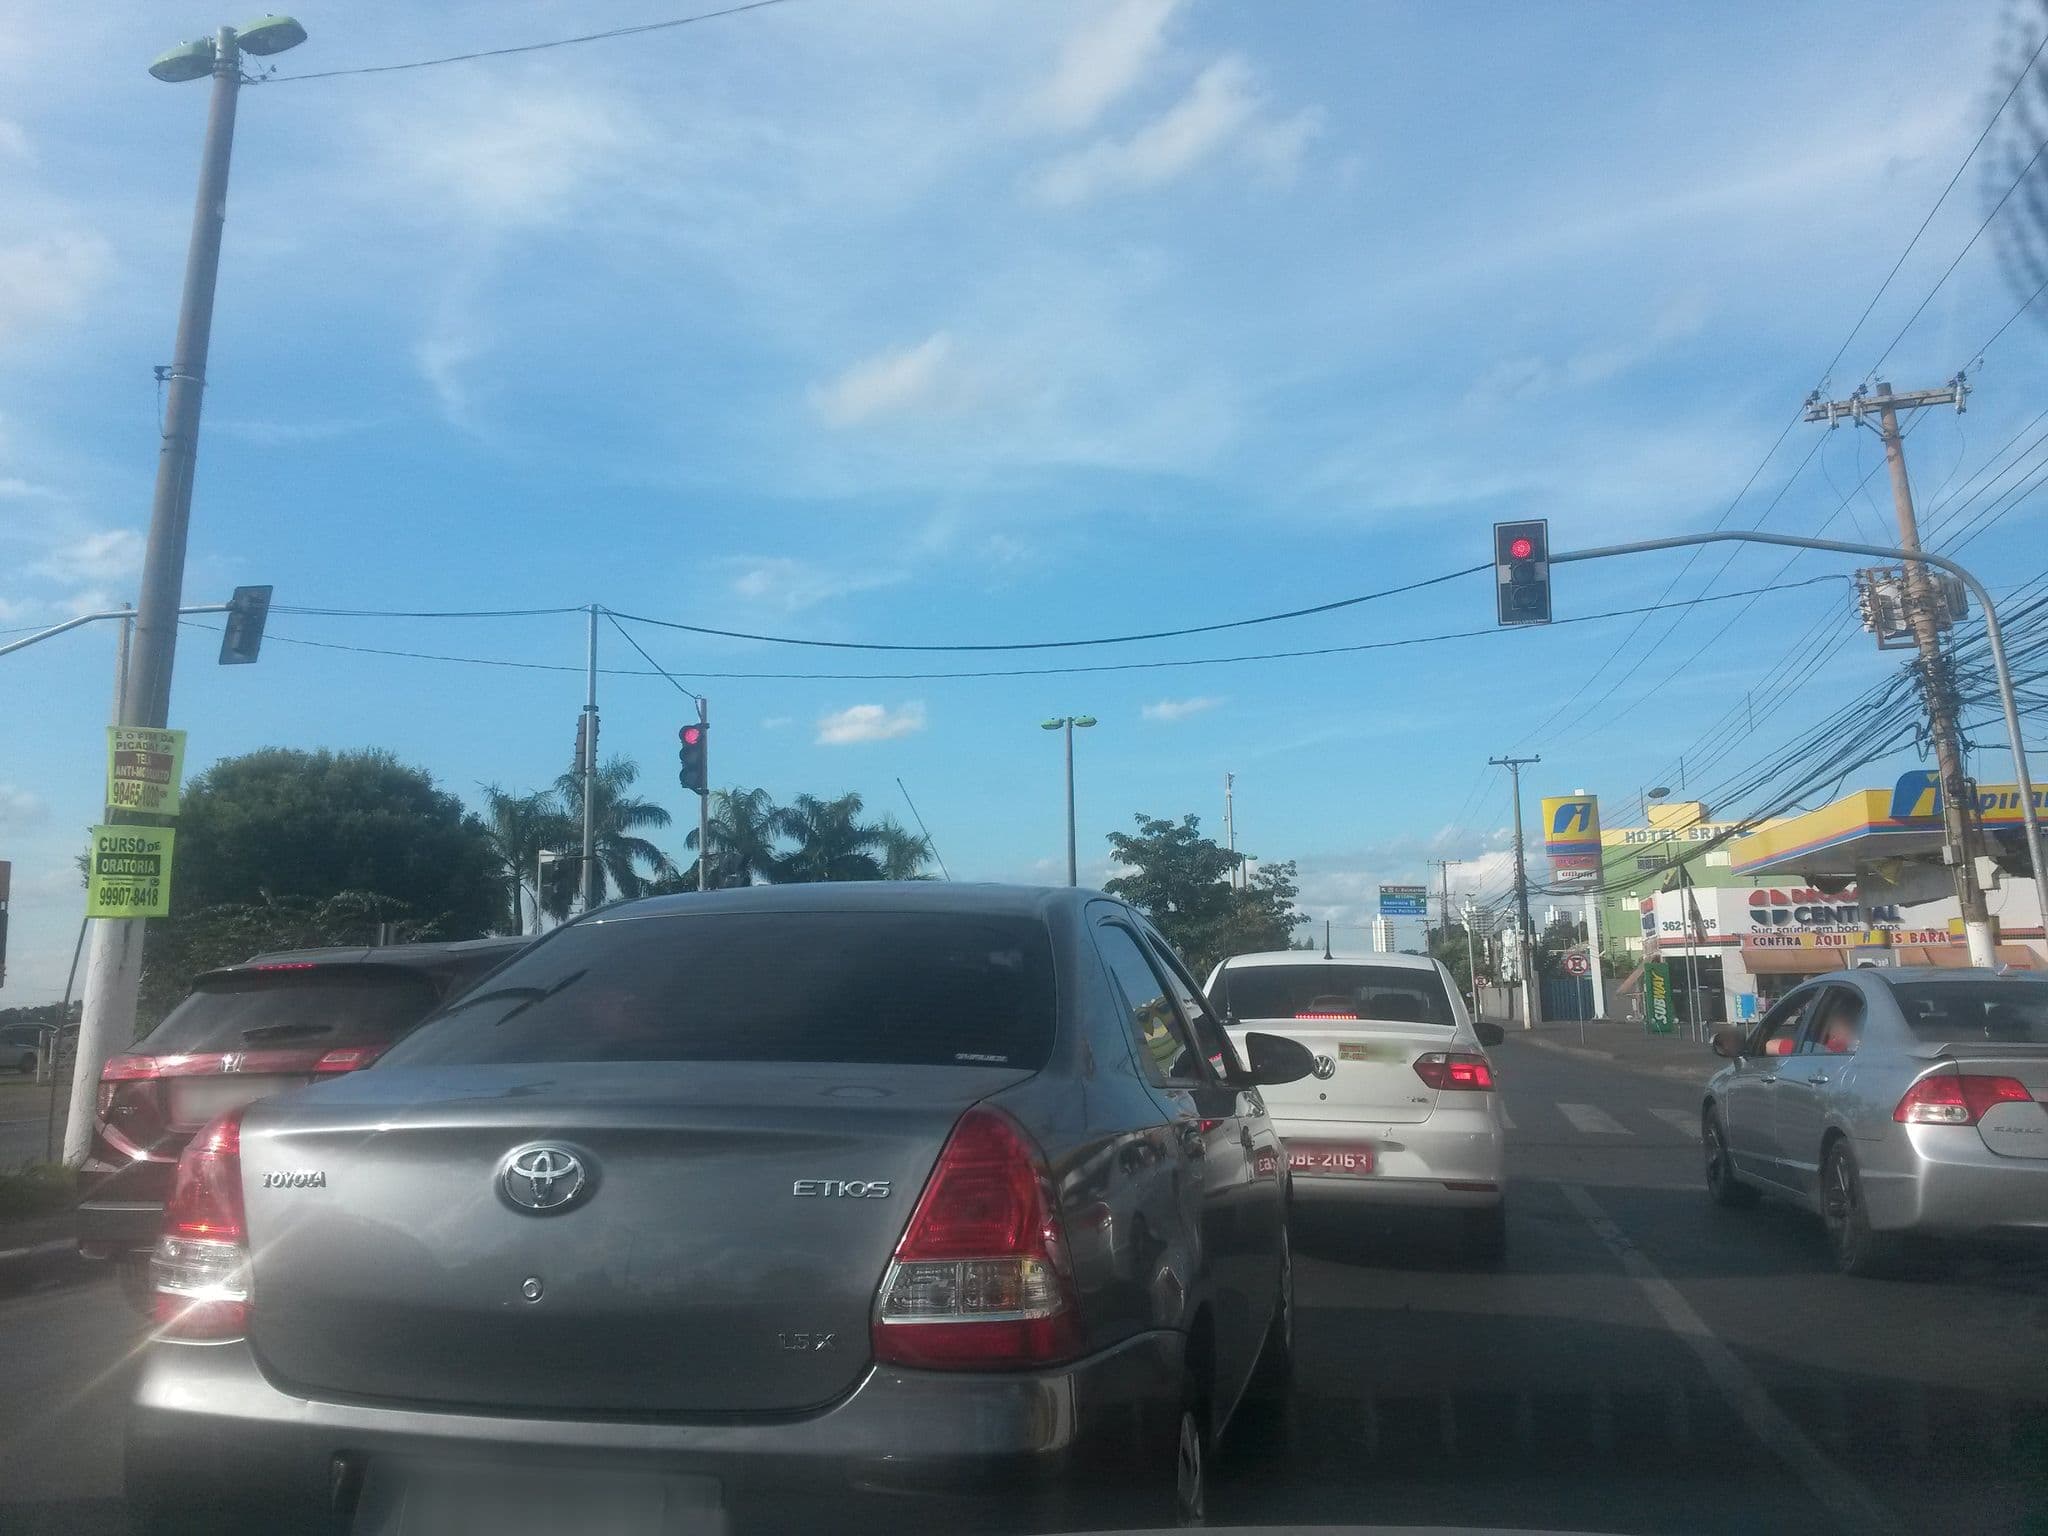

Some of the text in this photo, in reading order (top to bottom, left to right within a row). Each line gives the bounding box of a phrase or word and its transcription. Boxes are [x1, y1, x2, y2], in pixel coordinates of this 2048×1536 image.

[99, 837, 161, 853] CURSO DE
[1625, 828, 1682, 844] HOTEL
[1794, 904, 1904, 925] CENTAL
[1752, 936, 1802, 947] CONFIRA
[1815, 934, 1848, 947] AQUI
[1651, 969, 1668, 1025] SUBWAY
[263, 1170, 327, 1189] TOYOTA
[792, 1179, 891, 1198] ETIOS
